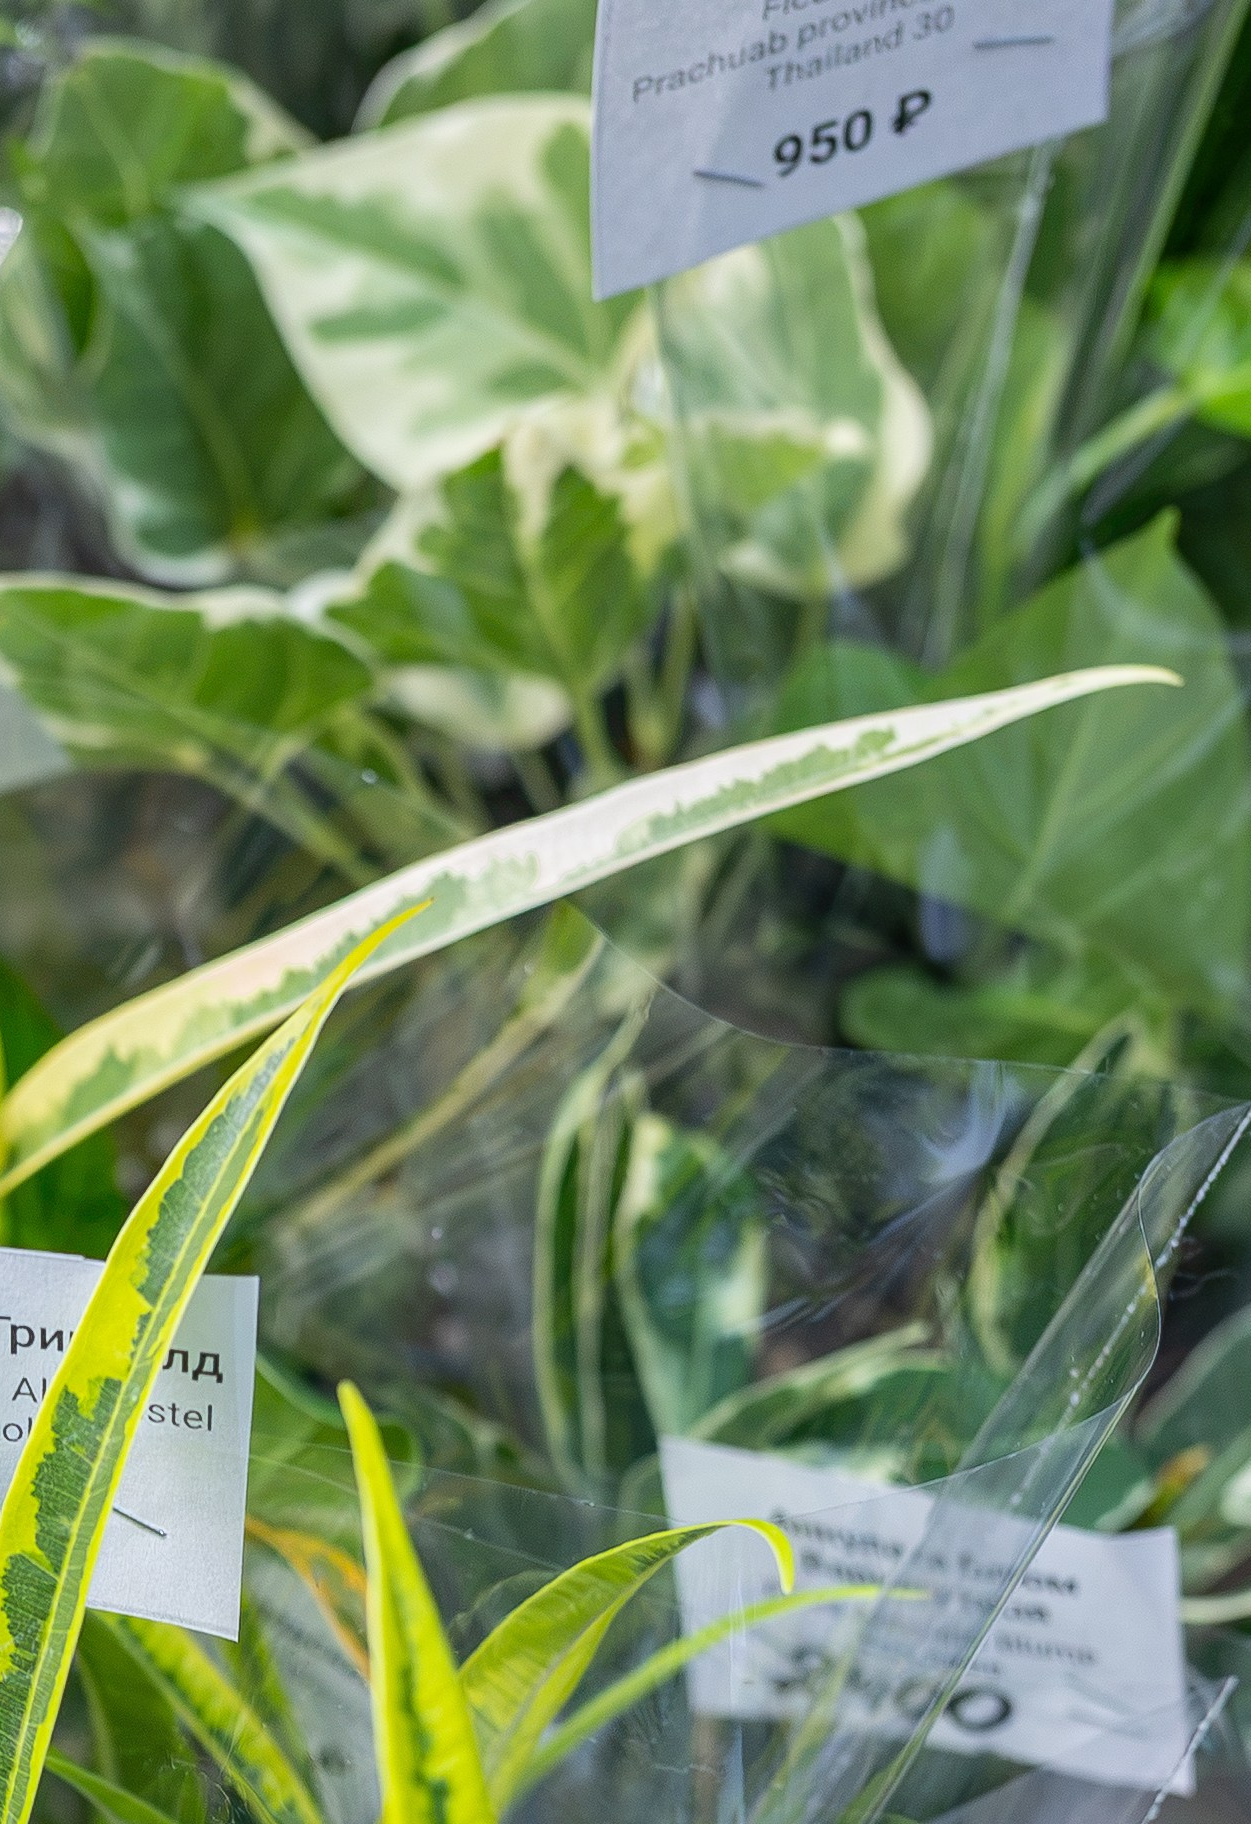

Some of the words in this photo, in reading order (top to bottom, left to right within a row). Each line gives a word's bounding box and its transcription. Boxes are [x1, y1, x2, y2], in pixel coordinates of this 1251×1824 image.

[766, 21, 904, 90] Thailand
[912, 6, 955, 41] 30
[772, 107, 873, 178] 950
[12, 1376, 48, 1404] Al
[147, 1402, 213, 1432] stel
